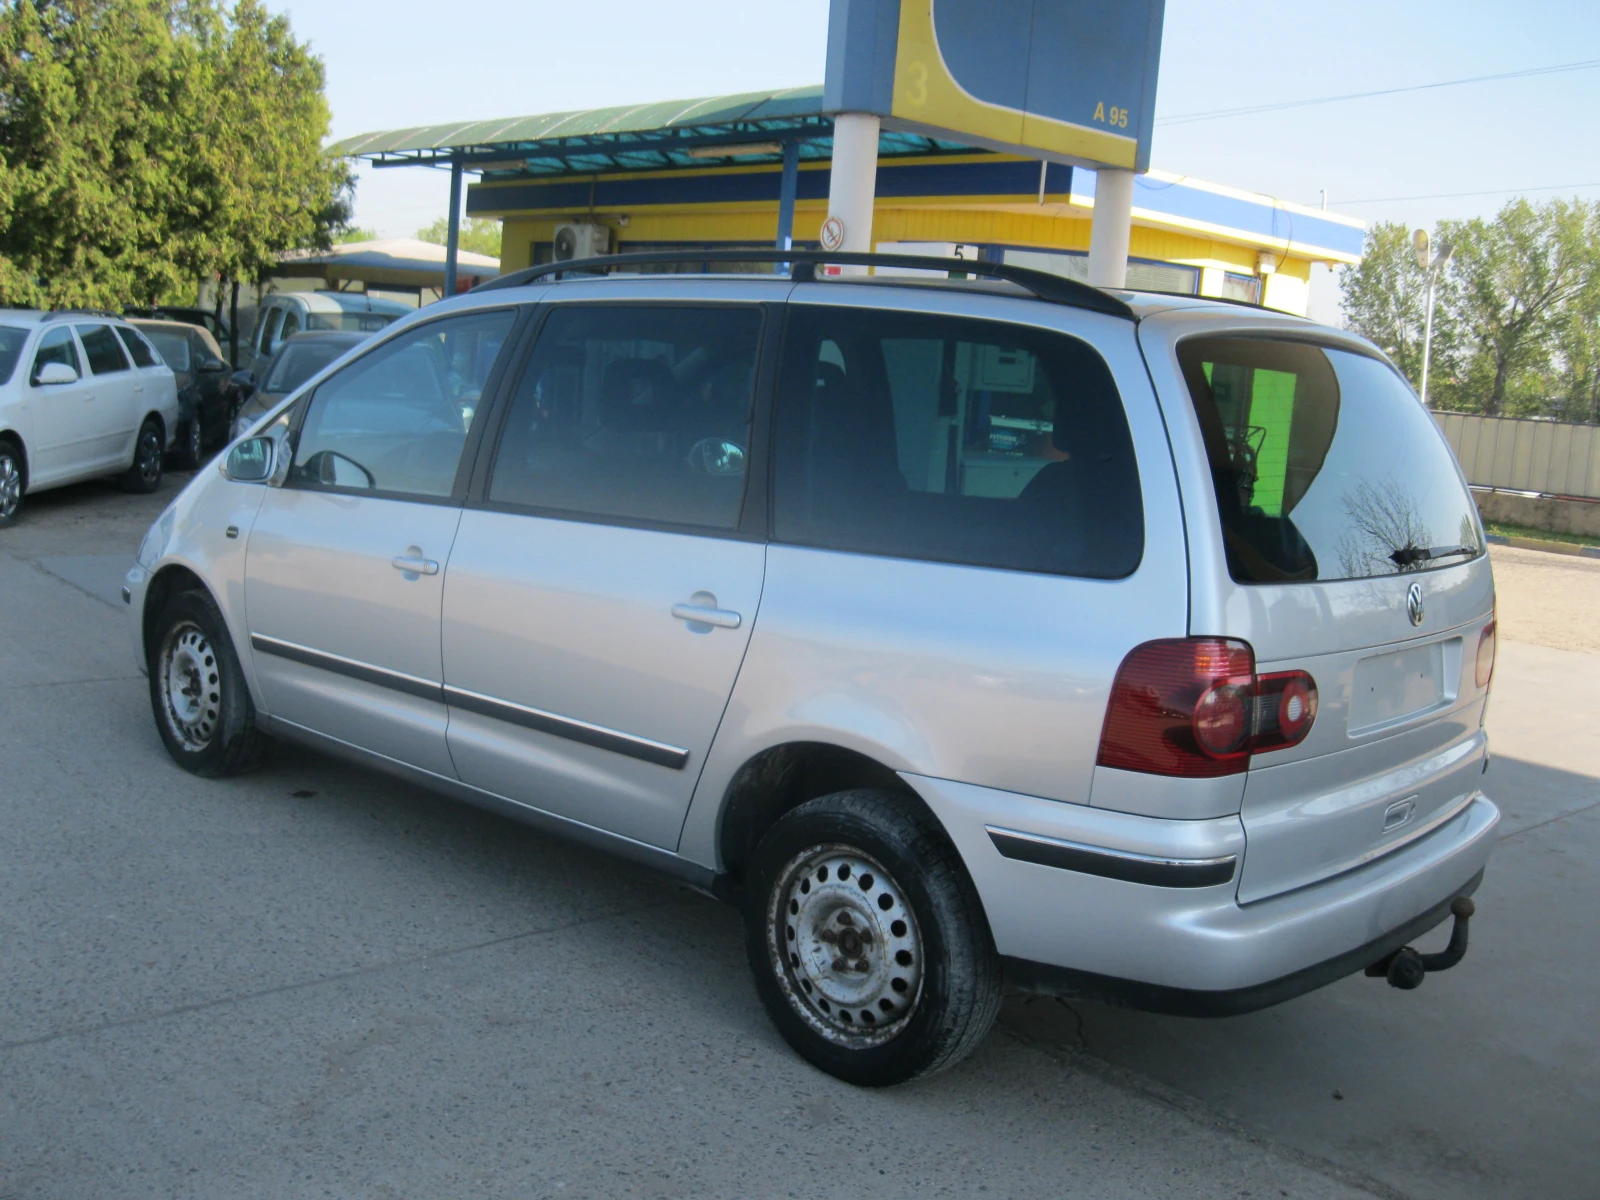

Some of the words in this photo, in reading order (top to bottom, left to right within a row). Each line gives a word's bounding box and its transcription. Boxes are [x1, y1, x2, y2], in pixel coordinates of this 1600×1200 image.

[906, 61, 927, 106] 3
[1093, 100, 1105, 122] A
[1109, 106, 1128, 128] 95
